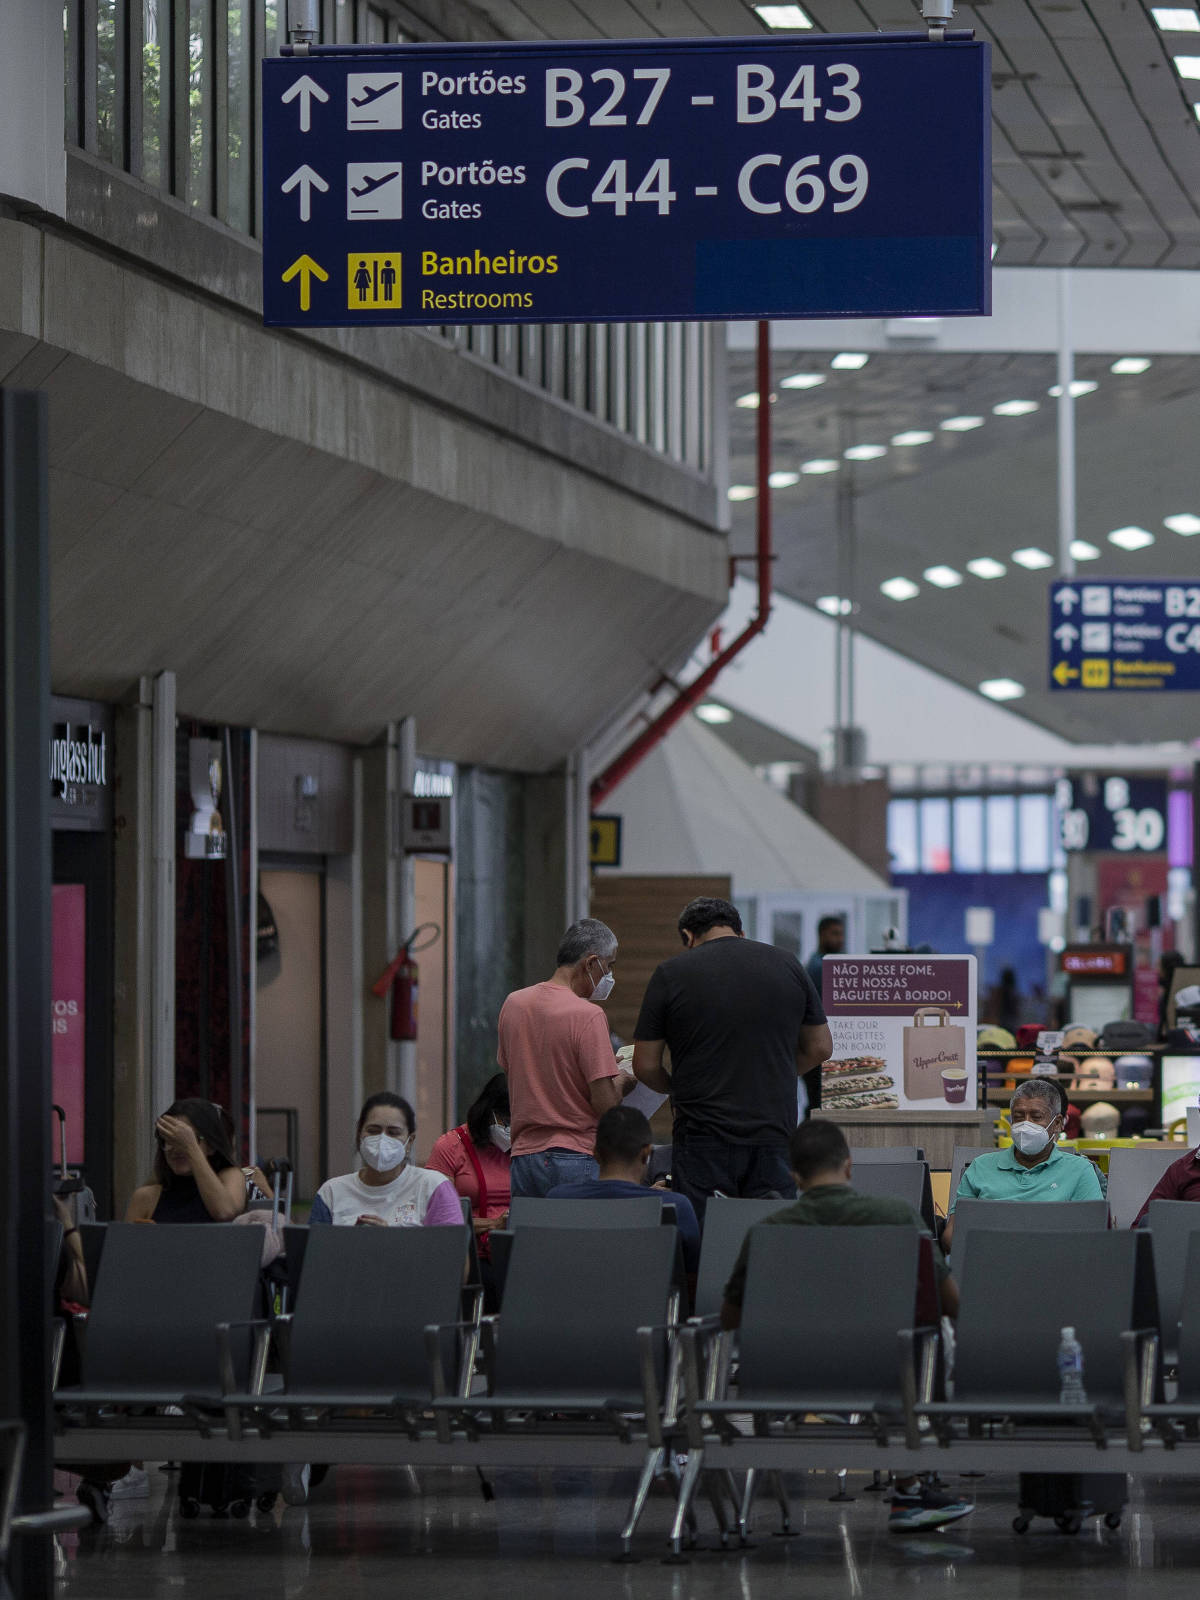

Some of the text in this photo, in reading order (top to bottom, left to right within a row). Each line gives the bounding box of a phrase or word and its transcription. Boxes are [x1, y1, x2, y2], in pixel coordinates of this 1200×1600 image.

[422, 69, 526, 96] Portões
[545, 68, 671, 127] B27
[736, 63, 862, 124] B43
[422, 109, 482, 130] Gates
[422, 159, 526, 186] Portões
[545, 157, 677, 217] C44
[737, 153, 869, 215] C69
[422, 199, 482, 219] Gates
[422, 249, 559, 276] Banheiros
[422, 289, 533, 309] Restrooms
[1104, 776, 1129, 810] B
[1111, 808, 1163, 850] 30
[832, 963, 859, 976] NÃO
[862, 964, 896, 976] PASSE
[832, 977, 908, 988] LEVE NOSSAS
[832, 990, 951, 1001] BAGUETES A BORDO!
[833, 1020, 879, 1030] TAKE OUR
[833, 1031, 885, 1041] BAGUETTES
